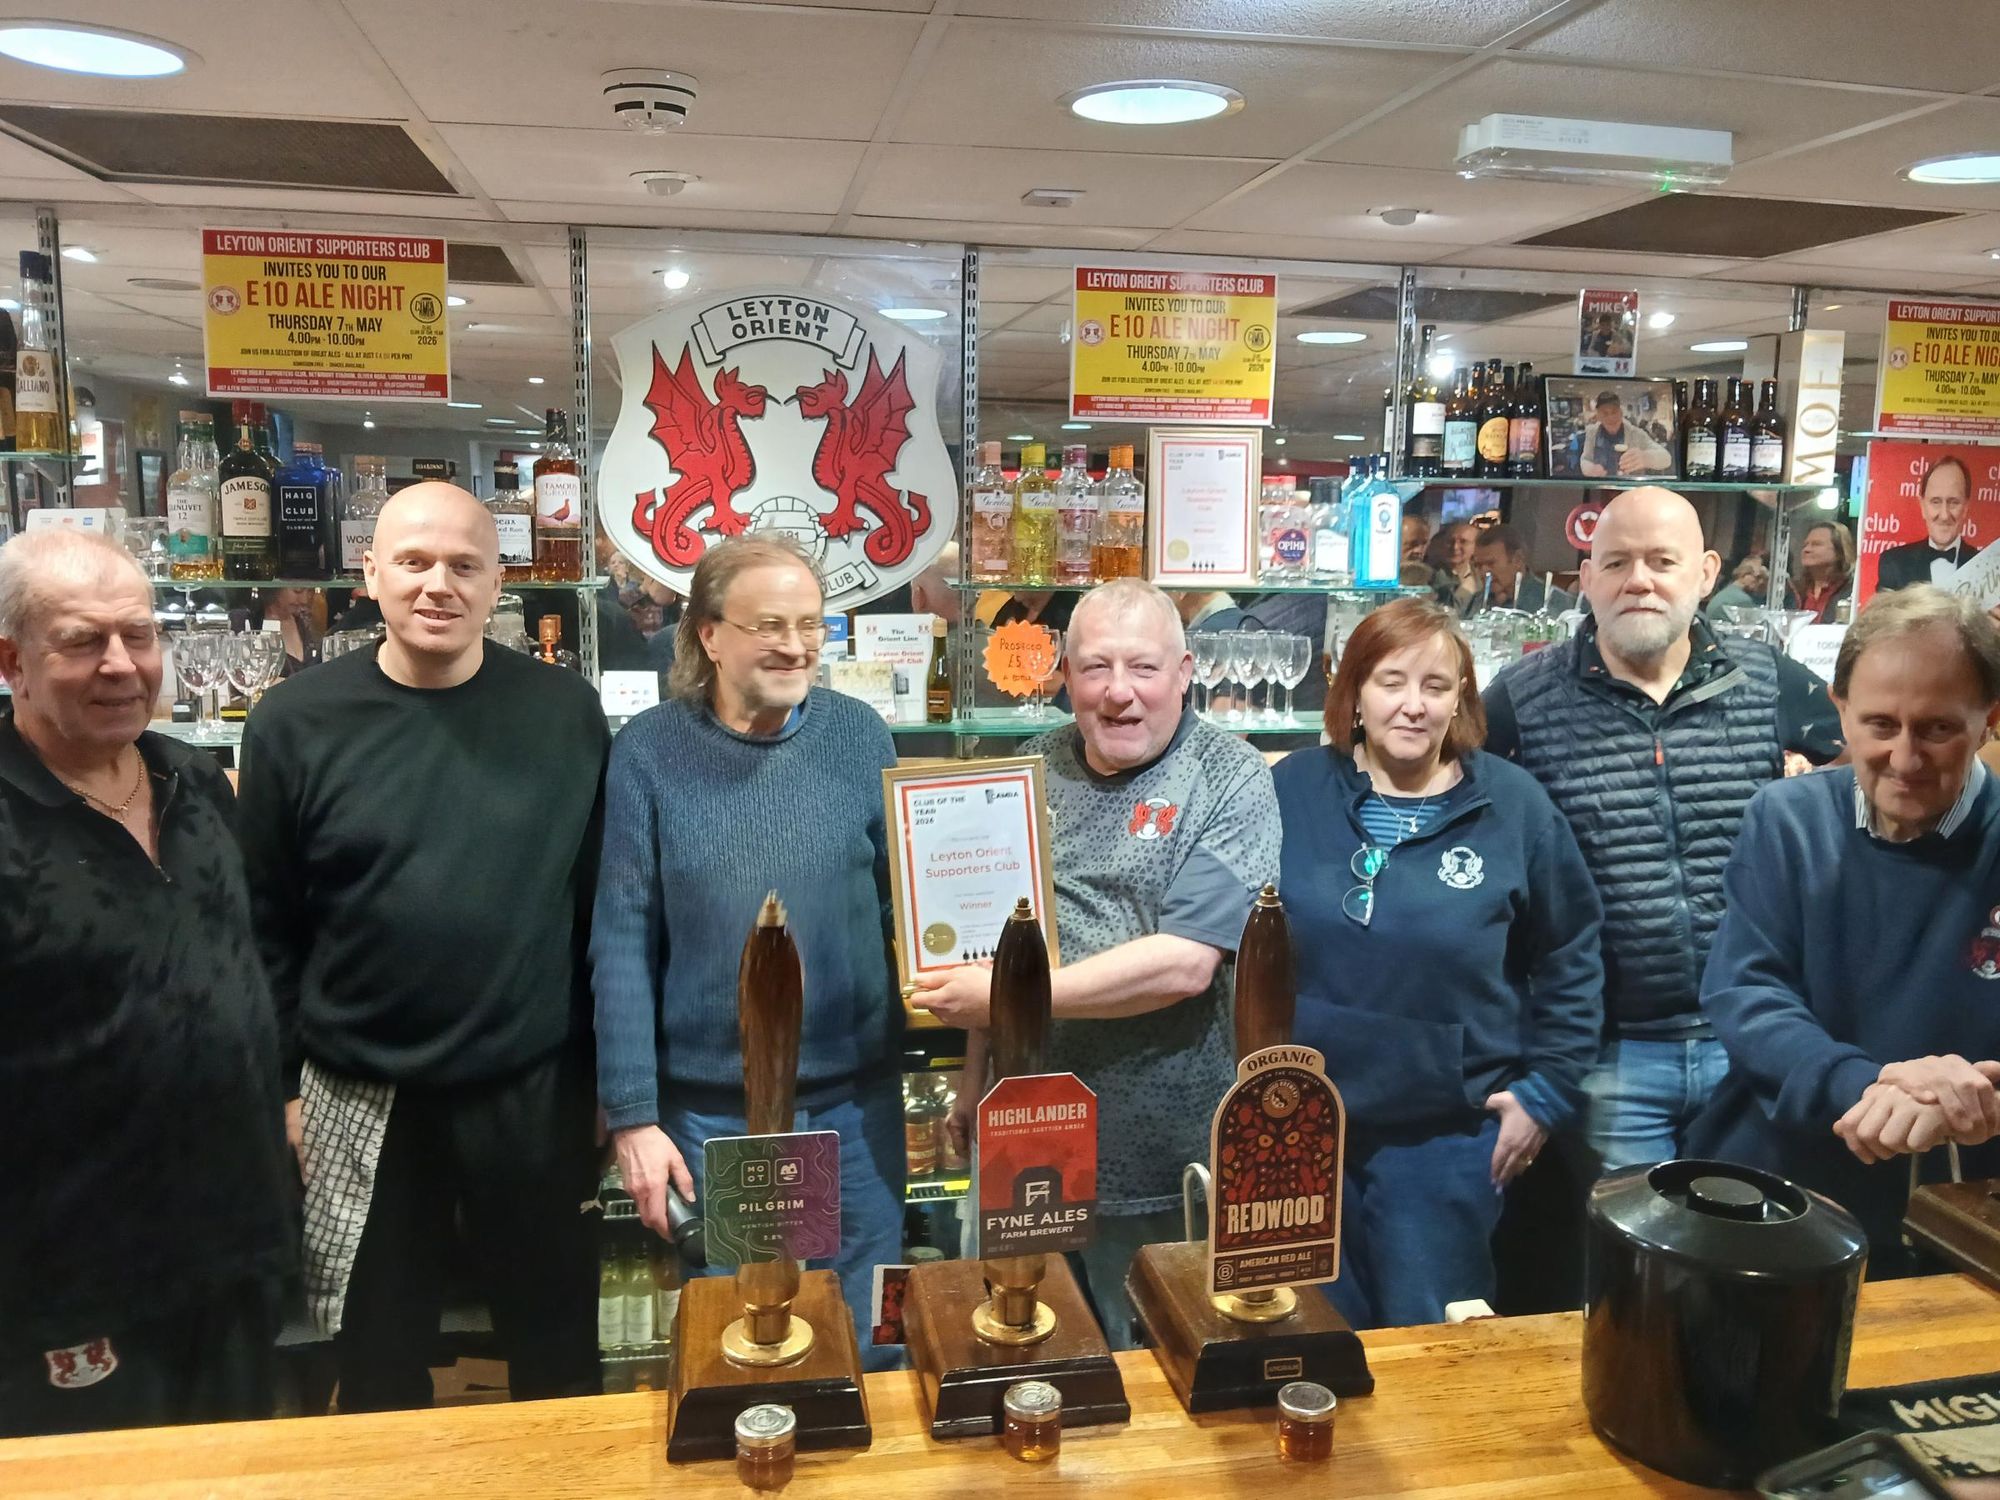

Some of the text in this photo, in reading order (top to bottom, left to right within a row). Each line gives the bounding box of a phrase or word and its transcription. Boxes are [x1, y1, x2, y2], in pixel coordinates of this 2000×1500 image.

[216, 235, 431, 259] LEYTON ORIENT SUPPORTERS CLUB
[263, 261, 387, 281] INVITES YOU TO OUR
[1087, 271, 1265, 294] LEYTON ORIENT SUPPORTERS CLUB
[295, 282, 334, 309] ALE
[341, 284, 405, 311] NIGHT
[1124, 296, 1226, 314] INVITES YOU TO OUR
[726, 300, 830, 324] LEYTON
[1588, 301, 1630, 313] MIKEY
[1897, 304, 1931, 320] LEYTON
[1931, 306, 1963, 321] ORIENT
[268, 313, 332, 332] THURSDAY
[356, 317, 383, 333] MAY
[731, 318, 829, 341] ORIENT
[1149, 316, 1183, 341] ALE
[1187, 317, 1241, 342] NIGHT
[287, 331, 365, 347] 4.00PM 10.00PM
[417, 335, 438, 346] 2026
[1926, 326, 1958, 341] INVITES
[1960, 328, 1978, 342] YOU
[1980, 329, 1991, 343] TO
[1126, 344, 1180, 360] THURSDAY
[1198, 347, 1222, 361] MAY
[1942, 344, 1972, 366] ALE
[1141, 360, 1206, 374] 4.00PM 10.00PM
[1925, 369, 1967, 384] THURSDAY
[1980, 372, 2000, 385] MAY
[1935, 384, 1986, 397] 4.00PM 10.00PM
[224, 481, 272, 496] JAMESON
[285, 492, 314, 501] HAIG
[177, 511, 188, 521] 12
[285, 507, 315, 515] CLUB
[1864, 512, 1900, 533] club
[913, 798, 936, 807] CLUB
[937, 797, 948, 805] OF
[950, 796, 967, 804] THE
[914, 807, 937, 816] YEAR
[915, 817, 936, 826] 2026
[930, 846, 1013, 864] Leyton Orient
[925, 860, 1021, 880] Supporters Club
[959, 900, 993, 911] Winner
[1246, 1050, 1317, 1072] ORGANIC
[987, 1102, 1089, 1128] HIGHLANDER
[989, 1128, 1031, 1137] TRADITIONAL
[1032, 1124, 1063, 1134] SCOTTISH
[738, 1199, 805, 1214] PILGRIM
[1227, 1194, 1325, 1235] REDWOOD
[741, 1222, 775, 1230] KENTISH
[986, 1208, 1089, 1231] FYNE ALES
[1000, 1225, 1075, 1241] FARM BREWERY
[1239, 1250, 1312, 1269] AMERICAN RED ALE
